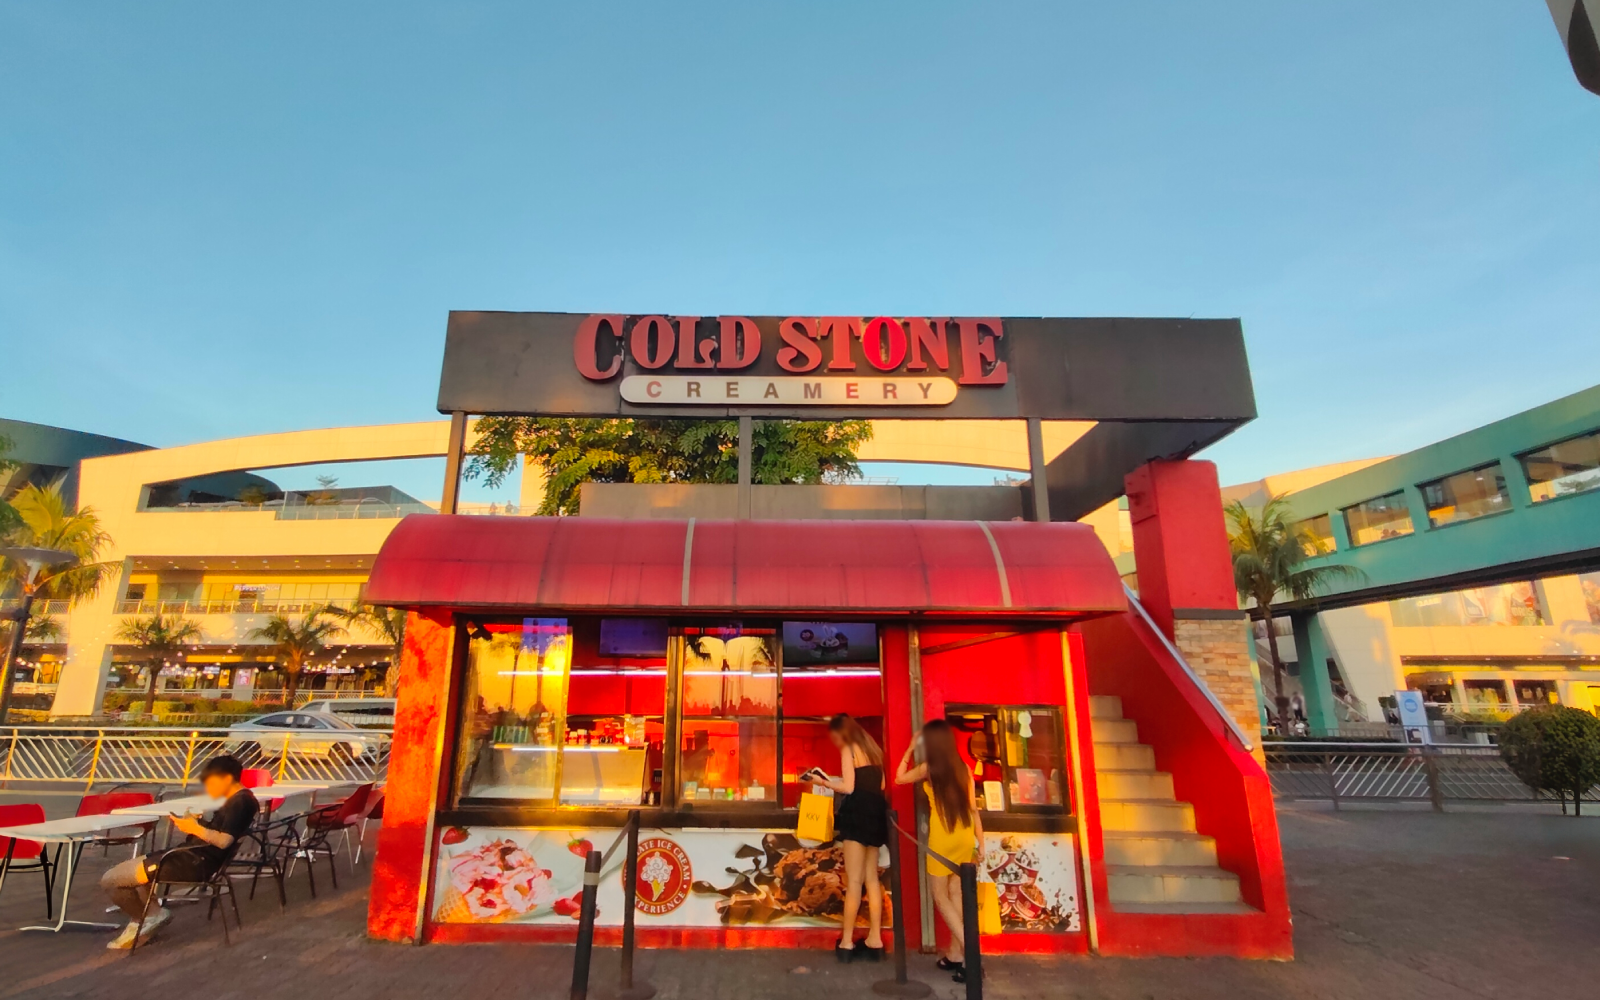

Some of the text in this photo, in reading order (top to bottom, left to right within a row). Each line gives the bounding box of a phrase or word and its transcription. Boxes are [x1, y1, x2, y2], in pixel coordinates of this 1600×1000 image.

[573, 315, 1008, 385] COLD STONE
[646, 381, 933, 399] CREAMERY
[806, 812, 821, 821] KKV
[657, 839, 690, 880] ICE CREAM
